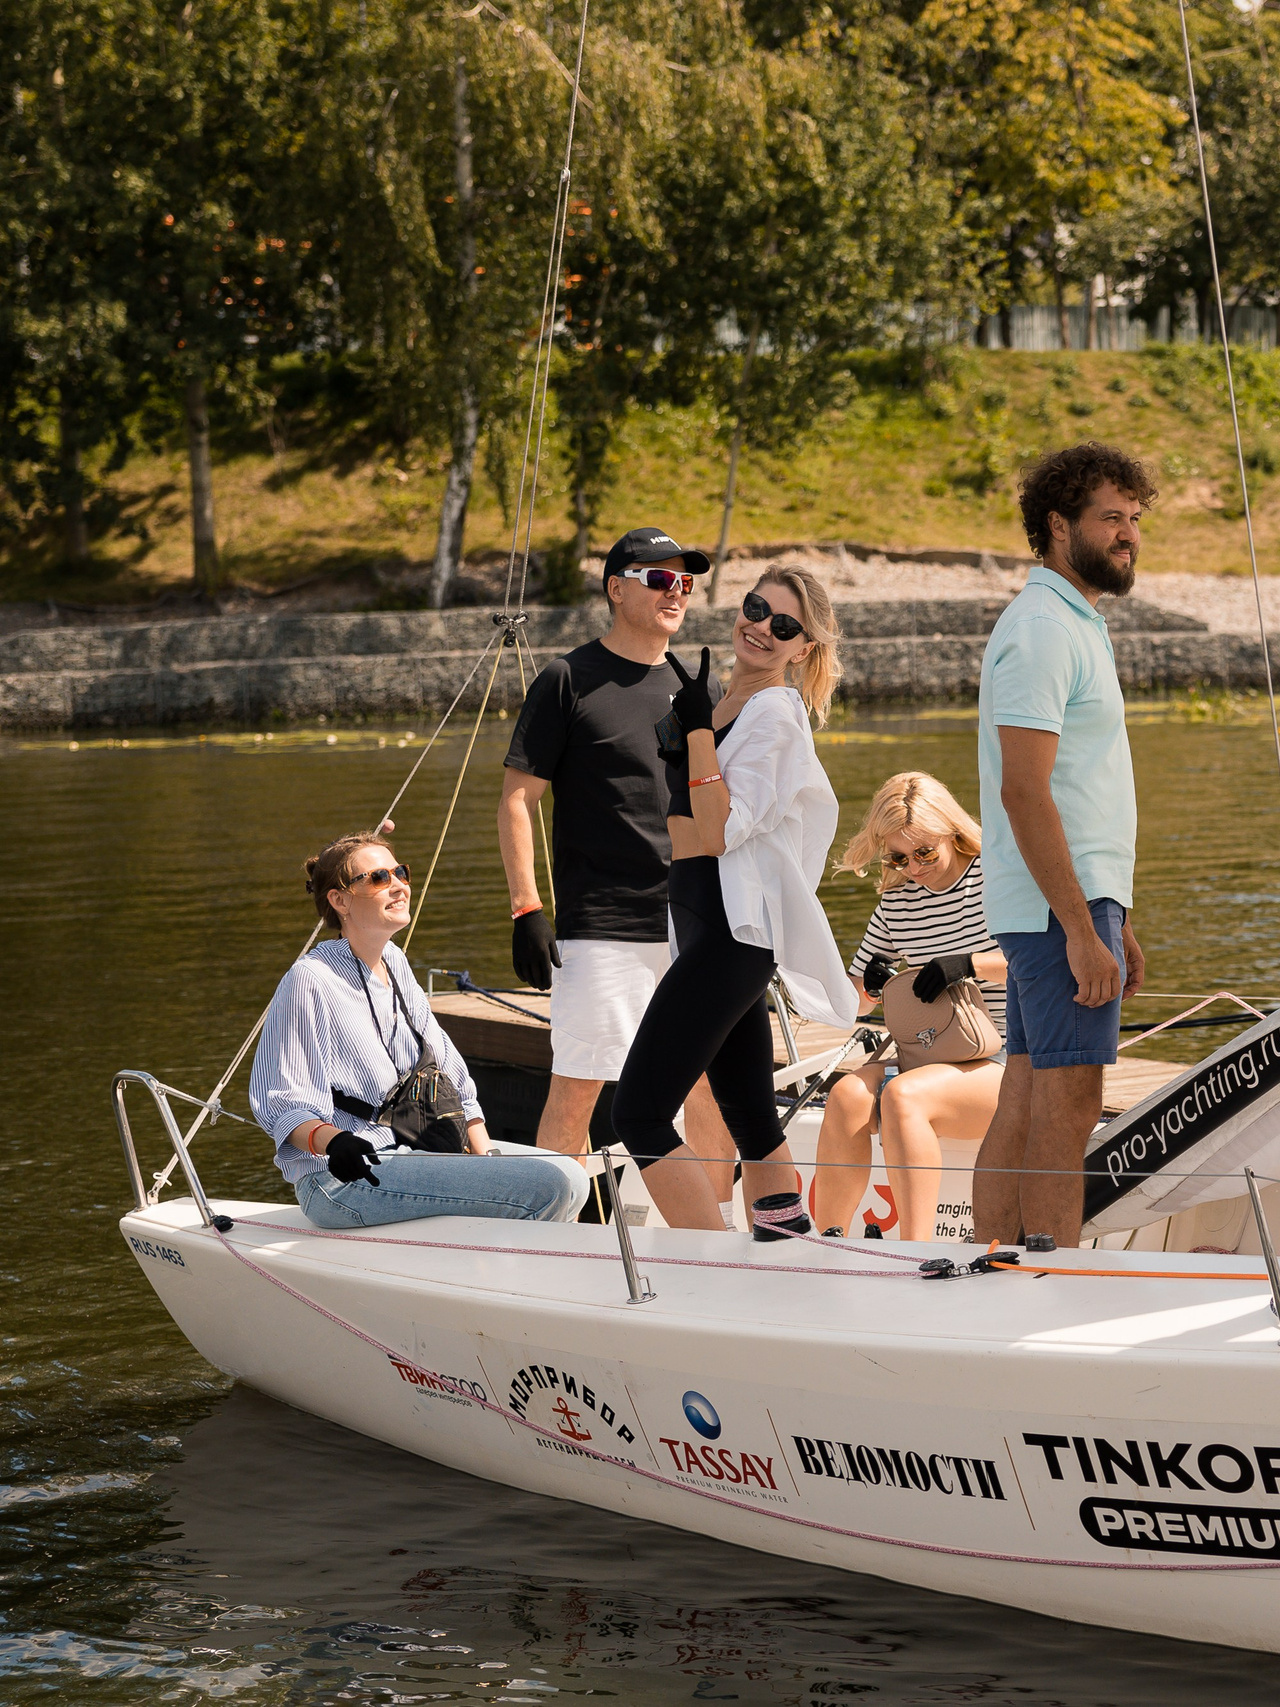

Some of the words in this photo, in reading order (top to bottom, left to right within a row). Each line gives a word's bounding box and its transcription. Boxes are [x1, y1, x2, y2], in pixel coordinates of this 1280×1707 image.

[129, 1237, 157, 1258] RUS
[936, 1222, 955, 1237] the
[508, 1364, 636, 1446] МОРПРИБОР
[658, 1437, 779, 1491] TASSAY
[790, 1435, 1008, 1501] ВЕДОМОСТИ
[675, 1474, 713, 1490] PREMIUM
[714, 1482, 758, 1499] DRINKING
[759, 1491, 789, 1504] WATER
